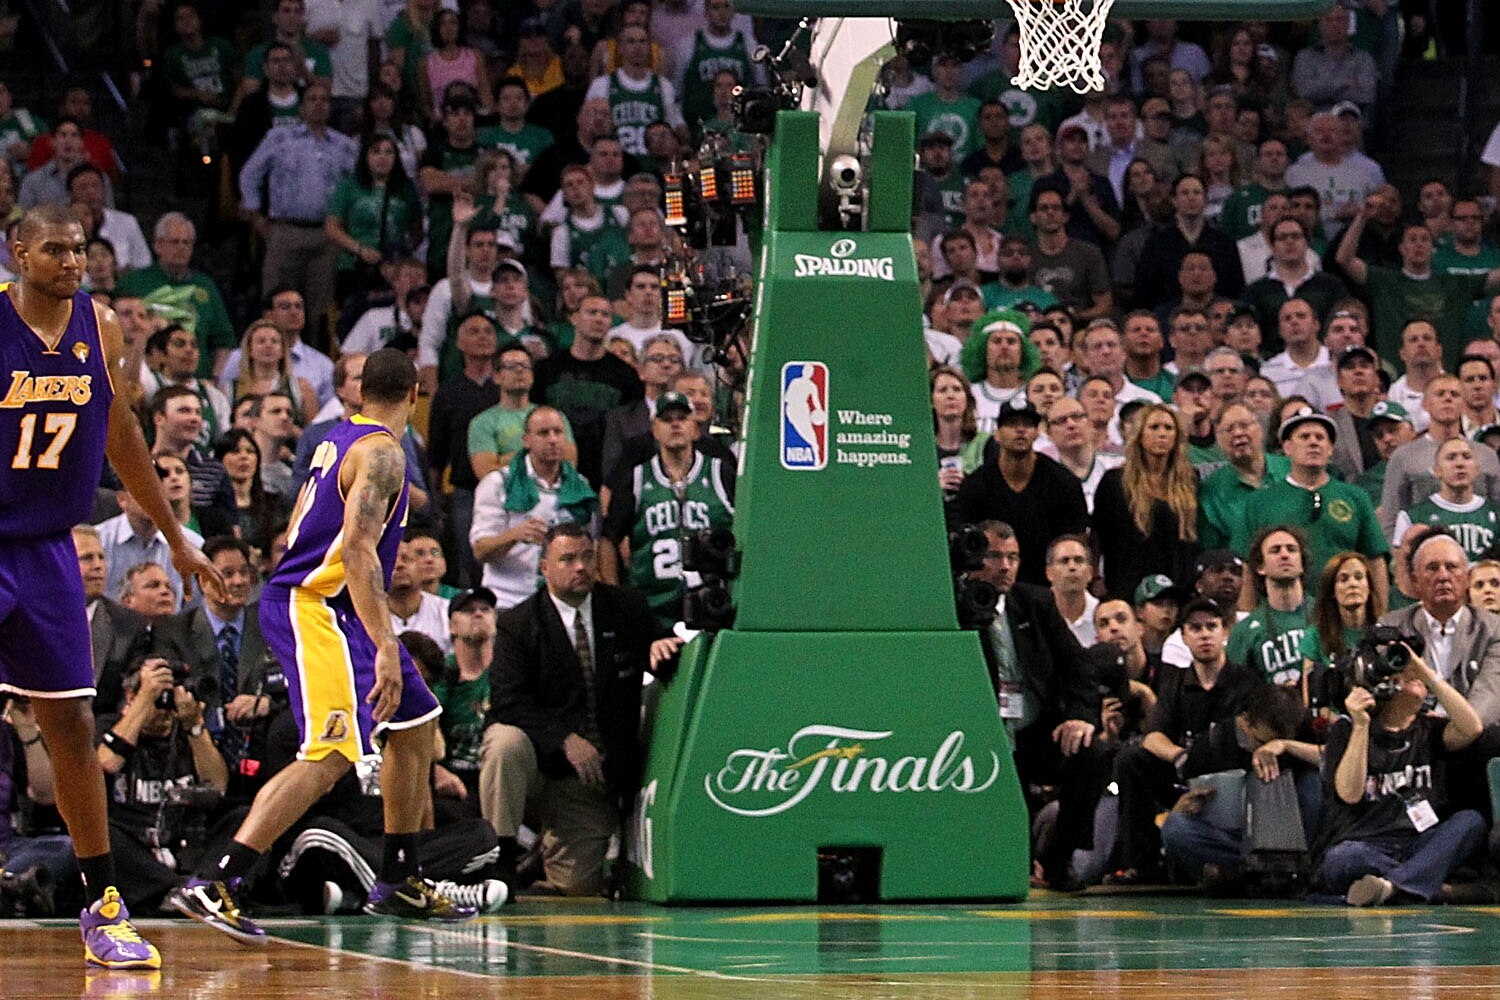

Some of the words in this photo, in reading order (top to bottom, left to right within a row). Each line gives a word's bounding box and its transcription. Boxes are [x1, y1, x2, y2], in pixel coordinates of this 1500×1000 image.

[794, 254, 895, 281] SPALDING
[0, 371, 92, 409] LAKERS
[837, 410, 893, 425] Where
[11, 412, 78, 469] 17
[836, 431, 911, 448] amazing
[786, 446, 813, 463] NBA
[837, 449, 913, 467] happens.
[705, 725, 999, 815] Finals
[717, 748, 797, 793] The
